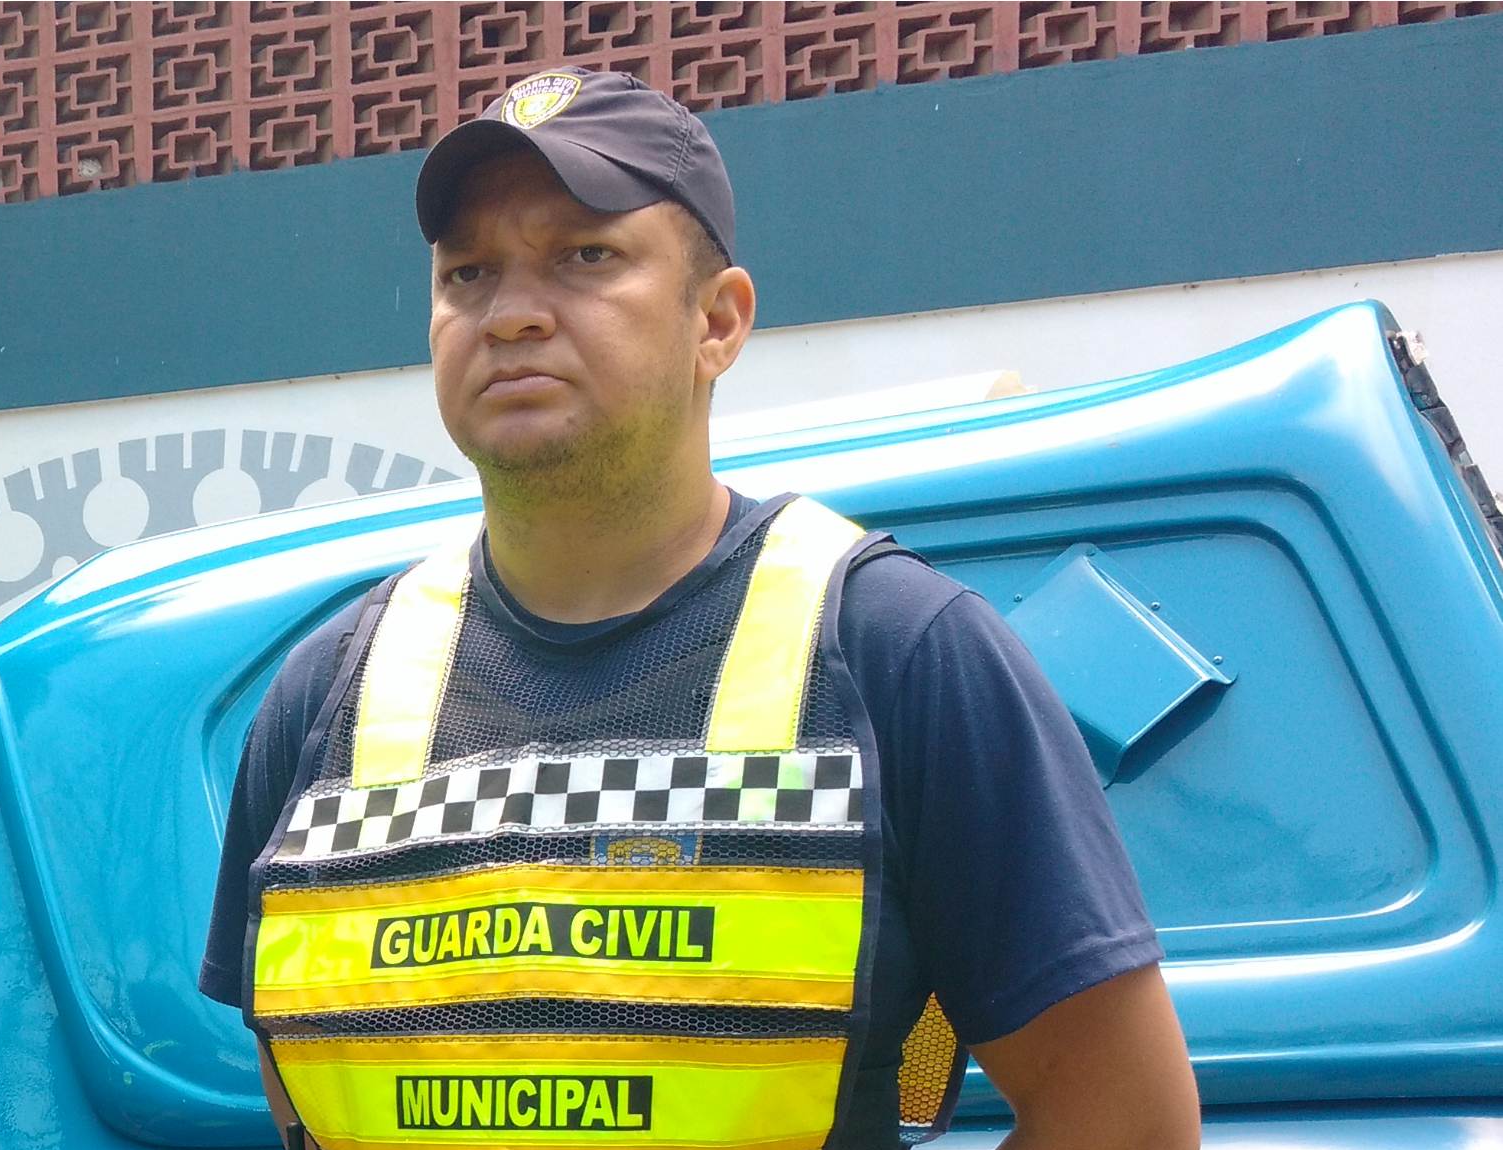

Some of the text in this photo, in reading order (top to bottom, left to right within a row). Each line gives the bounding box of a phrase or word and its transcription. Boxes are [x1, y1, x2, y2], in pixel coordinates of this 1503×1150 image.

[379, 907, 705, 964] GUARDA CIVIL
[401, 1078, 645, 1129] MUNICIPAL
